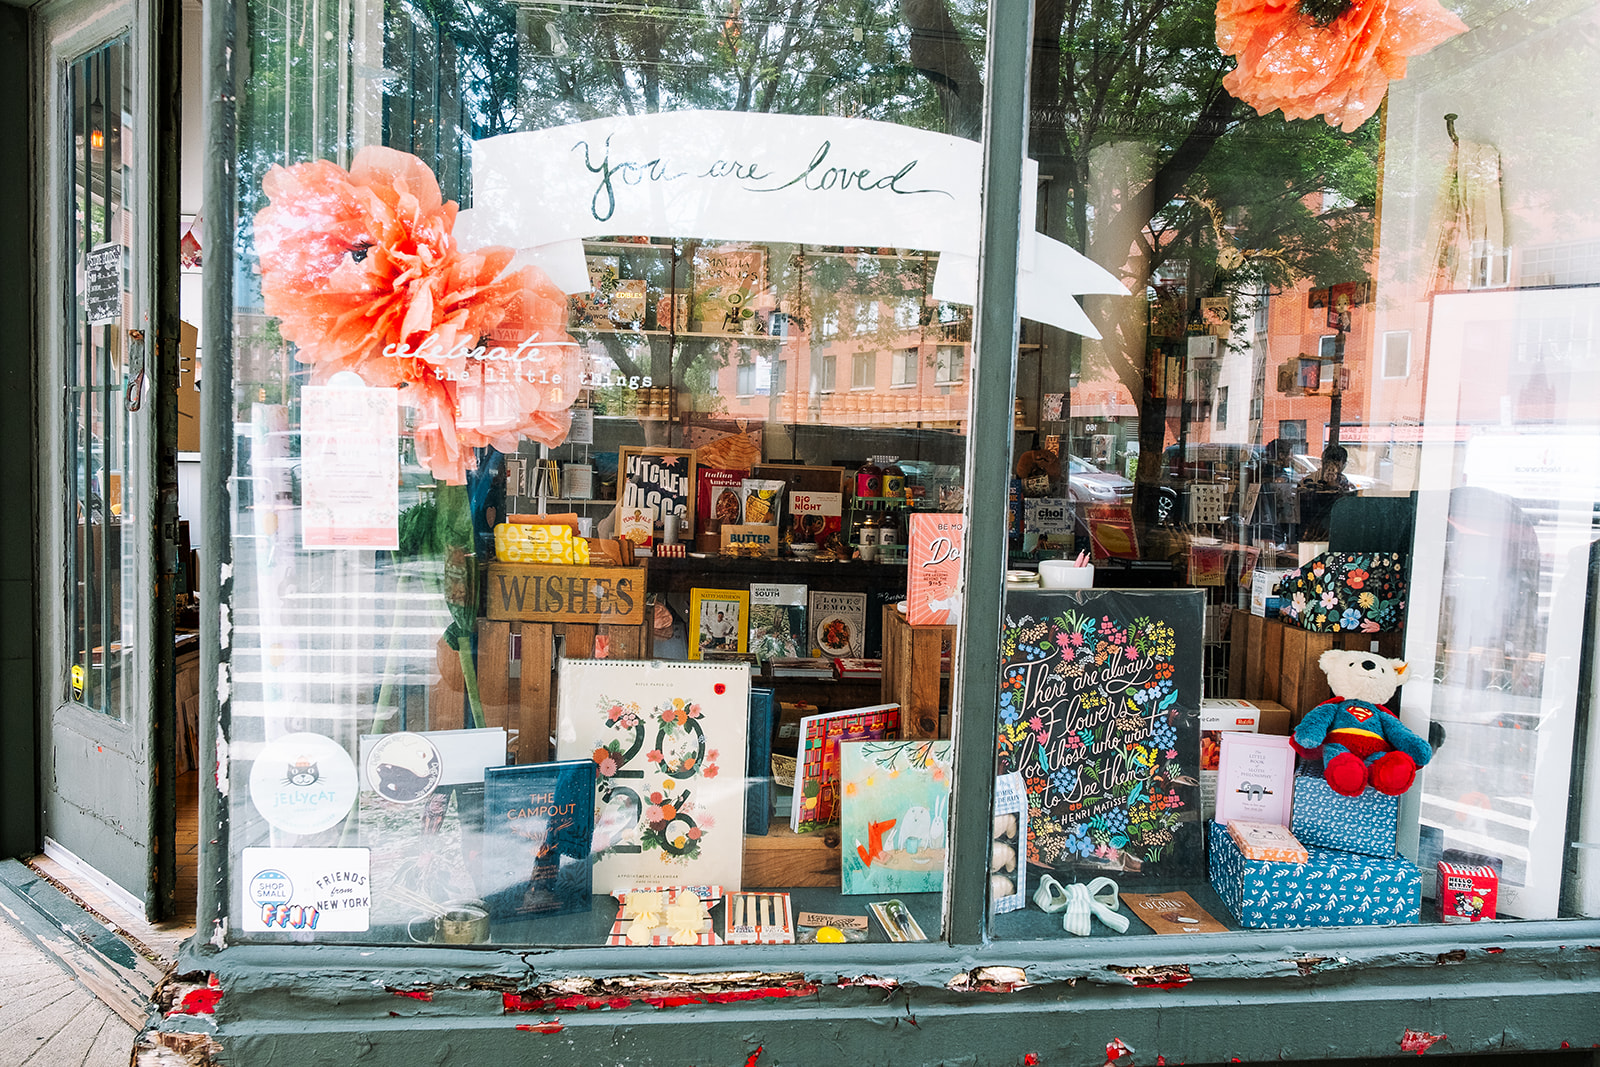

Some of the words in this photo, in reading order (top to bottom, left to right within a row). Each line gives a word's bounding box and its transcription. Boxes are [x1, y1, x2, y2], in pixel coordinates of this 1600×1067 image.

[571, 133, 687, 222] You
[698, 159, 774, 181] are
[742, 139, 955, 201] loved
[615, 291, 643, 300] EDIBLES
[382, 332, 579, 361] celebrate
[434, 366, 469, 381] the
[488, 367, 564, 385] little
[580, 370, 653, 392] things
[626, 455, 689, 497] KITCHEN
[704, 471, 733, 480] Italian
[710, 479, 743, 487] America
[1038, 507, 1064, 518] choi
[730, 534, 771, 544] BUTTER
[496, 574, 634, 616] WISHES
[823, 596, 852, 605] LOVE
[816, 603, 862, 613] LEMONS
[1004, 647, 1067, 721] There
[1073, 671, 1099, 692] are
[1101, 646, 1154, 695] always
[1036, 694, 1143, 750] Flowers
[1019, 732, 1048, 780] for
[1045, 738, 1093, 772] those
[1092, 719, 1122, 755] who
[1124, 700, 1169, 745] want
[1041, 771, 1063, 809] to
[1061, 763, 1100, 804] See
[1099, 754, 1152, 791] them
[529, 792, 556, 804] THE
[1093, 794, 1128, 814] MATISSE
[507, 803, 577, 821] CAMPOUT
[259, 882, 285, 891] SHOP
[316, 871, 368, 889] FRIENDS
[1449, 877, 1472, 885] HELLO
[256, 890, 287, 898] SMALL
[330, 886, 353, 898] from
[316, 900, 339, 911] NEW
[342, 897, 369, 908] YORK
